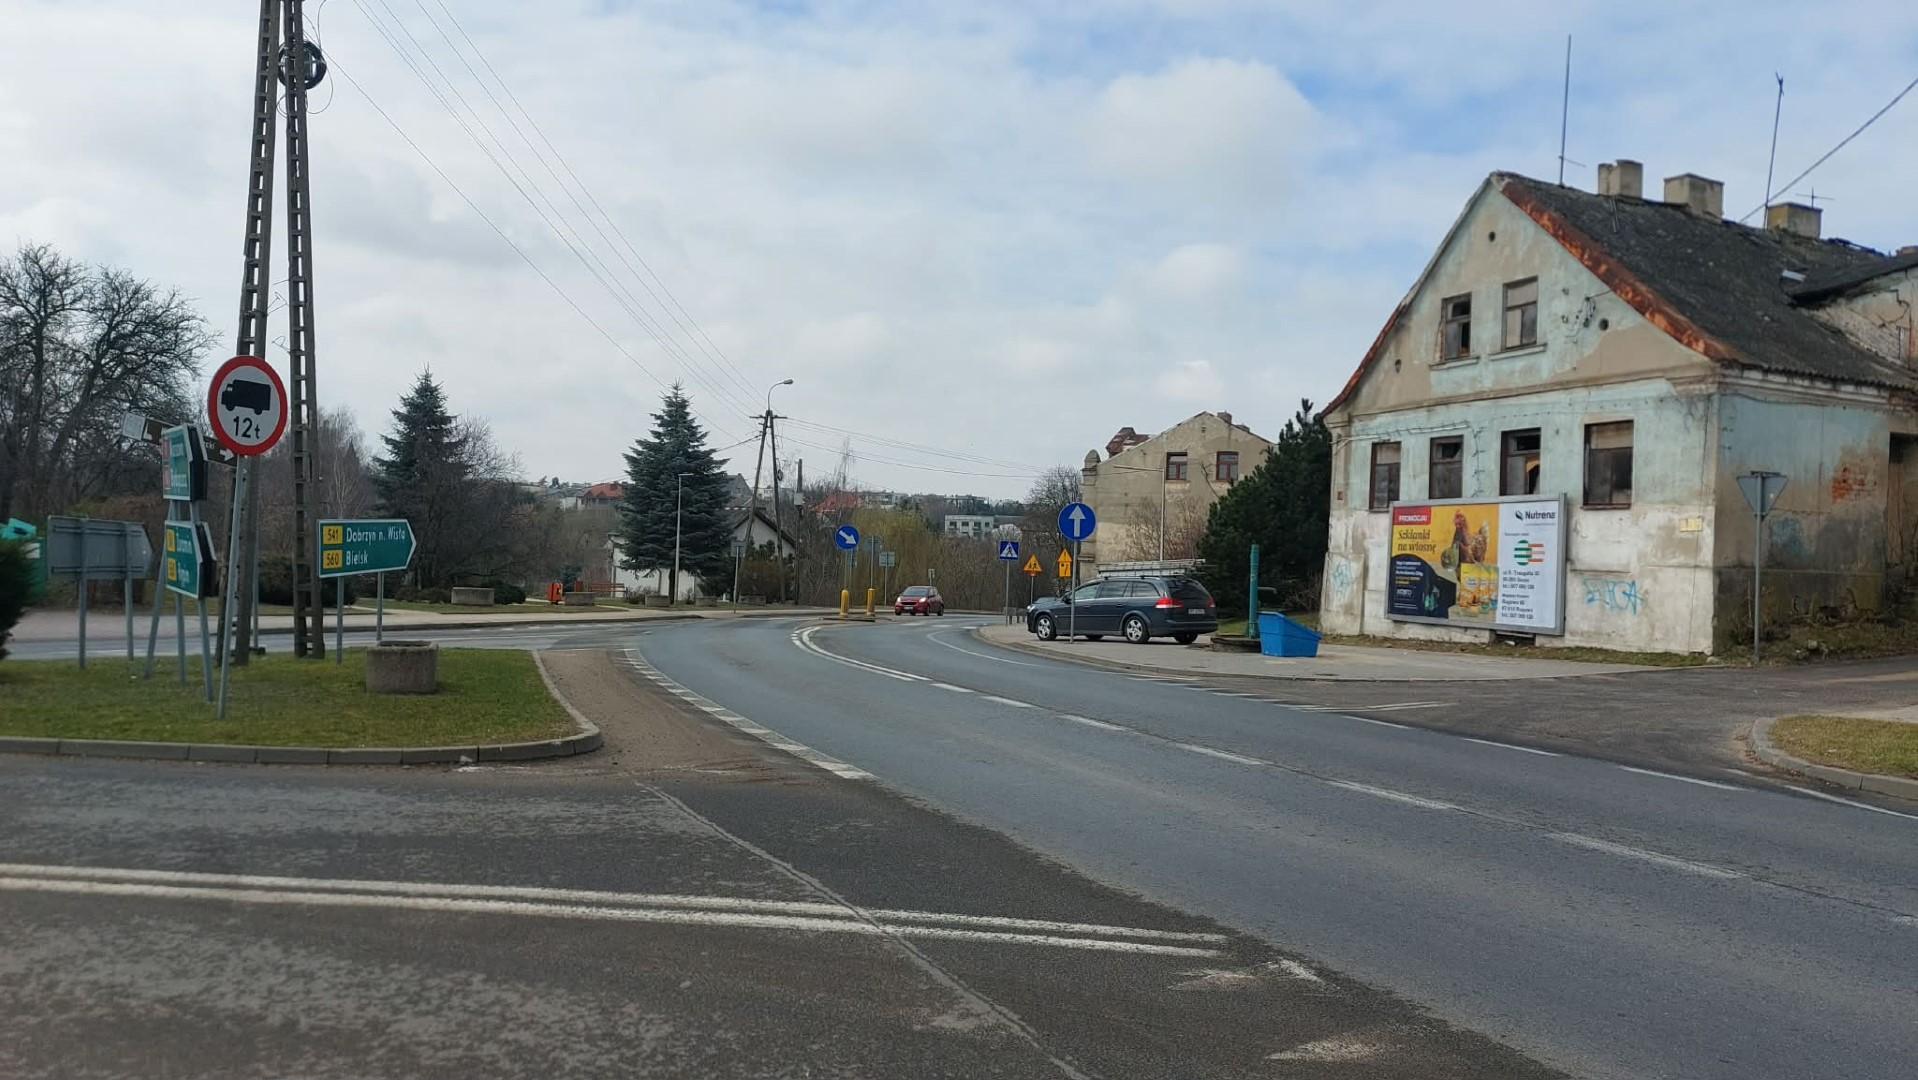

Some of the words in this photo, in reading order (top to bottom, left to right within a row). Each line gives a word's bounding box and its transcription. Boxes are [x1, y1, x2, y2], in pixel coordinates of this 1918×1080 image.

[1525, 511, 1556, 519] Nutrena
[327, 528, 338, 540] 541
[326, 553, 339, 566] 560
[346, 550, 369, 566] Bielsk
